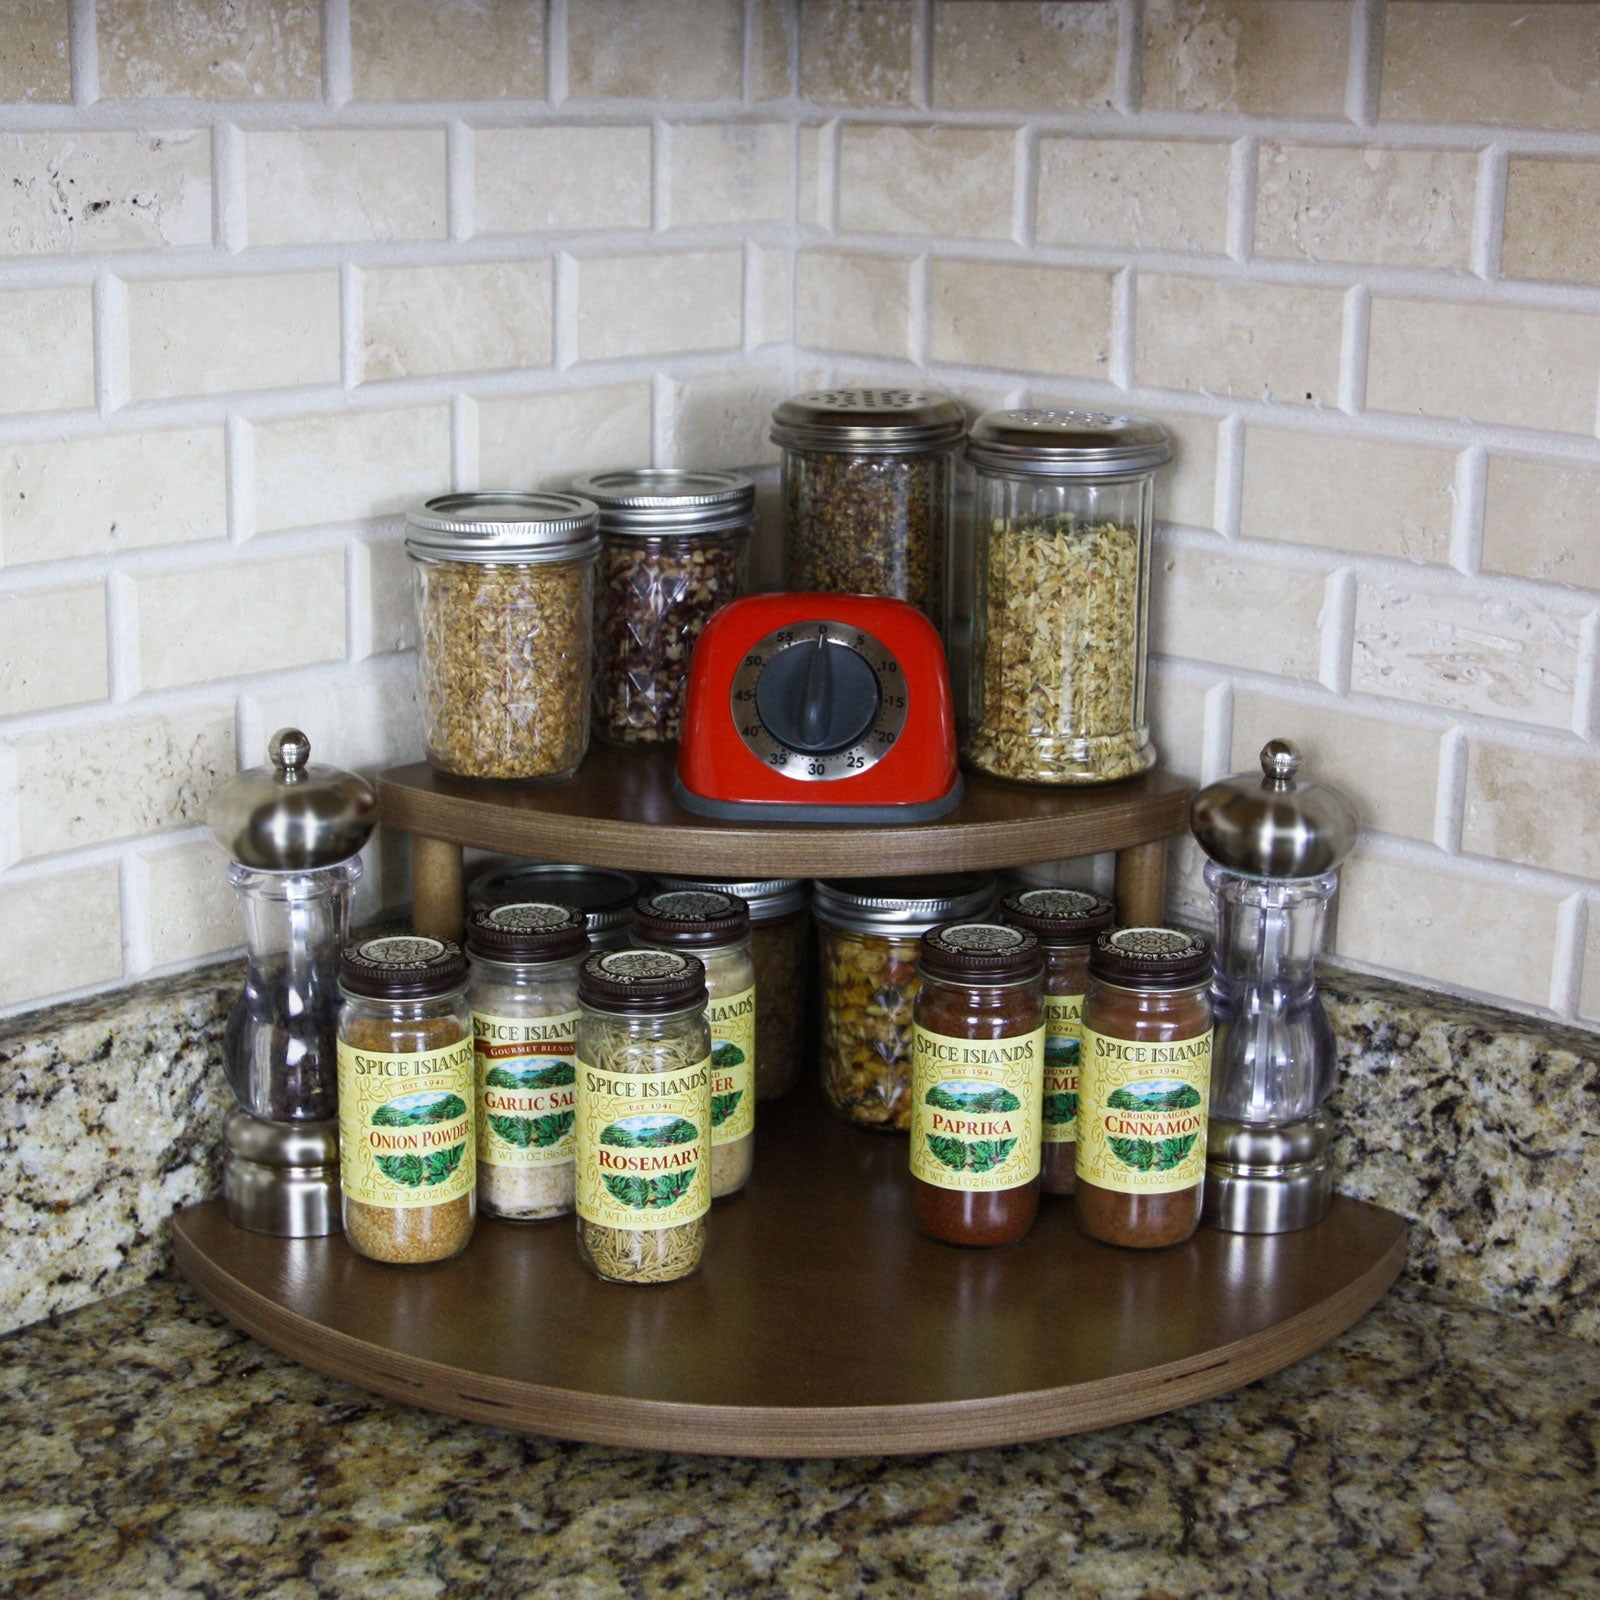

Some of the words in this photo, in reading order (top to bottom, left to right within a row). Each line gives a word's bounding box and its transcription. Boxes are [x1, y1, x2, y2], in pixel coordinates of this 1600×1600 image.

[819, 625, 827, 634] 0
[776, 632, 793, 642] 55
[857, 636, 864, 645] 5
[745, 656, 762, 667] 50
[882, 661, 897, 672] 10
[735, 691, 750, 700] 45
[888, 696, 904, 707] 15
[742, 726, 759, 737] 40
[878, 732, 895, 744] 20
[770, 753, 787, 765] 35
[846, 757, 864, 768] 25
[808, 764, 825, 776] 30
[1045, 1005, 1082, 1020] ISLA
[473, 1018, 519, 1041] SPICE
[525, 1018, 579, 1041] ISLAN
[490, 1045, 536, 1056] GOURMET
[917, 1034, 959, 1061] SPICE
[963, 1040, 1033, 1064] ISLANDS
[1095, 1038, 1147, 1062] SPICE
[1151, 1034, 1211, 1063] ISLANDS
[354, 1055, 409, 1077] SPICE
[414, 1041, 474, 1076] ISLANDS
[972, 1069, 994, 1077] 1941
[424, 1079, 445, 1087] 1941
[586, 1072, 638, 1098] SPICE
[642, 1067, 708, 1098] ISLANDS
[1043, 1076, 1078, 1091] TME
[484, 1091, 545, 1111] GARLIC
[549, 1092, 576, 1108] SAL
[651, 1102, 672, 1111] 1941
[1120, 1112, 1159, 1120] GROUND
[1162, 1109, 1191, 1119] SAIGON
[931, 1113, 1013, 1135] PAPRIKA
[1104, 1113, 1201, 1136] CINNAMON
[369, 1130, 418, 1150] ONION
[422, 1119, 470, 1148] POWDER
[598, 1145, 701, 1171] ROSEMARY
